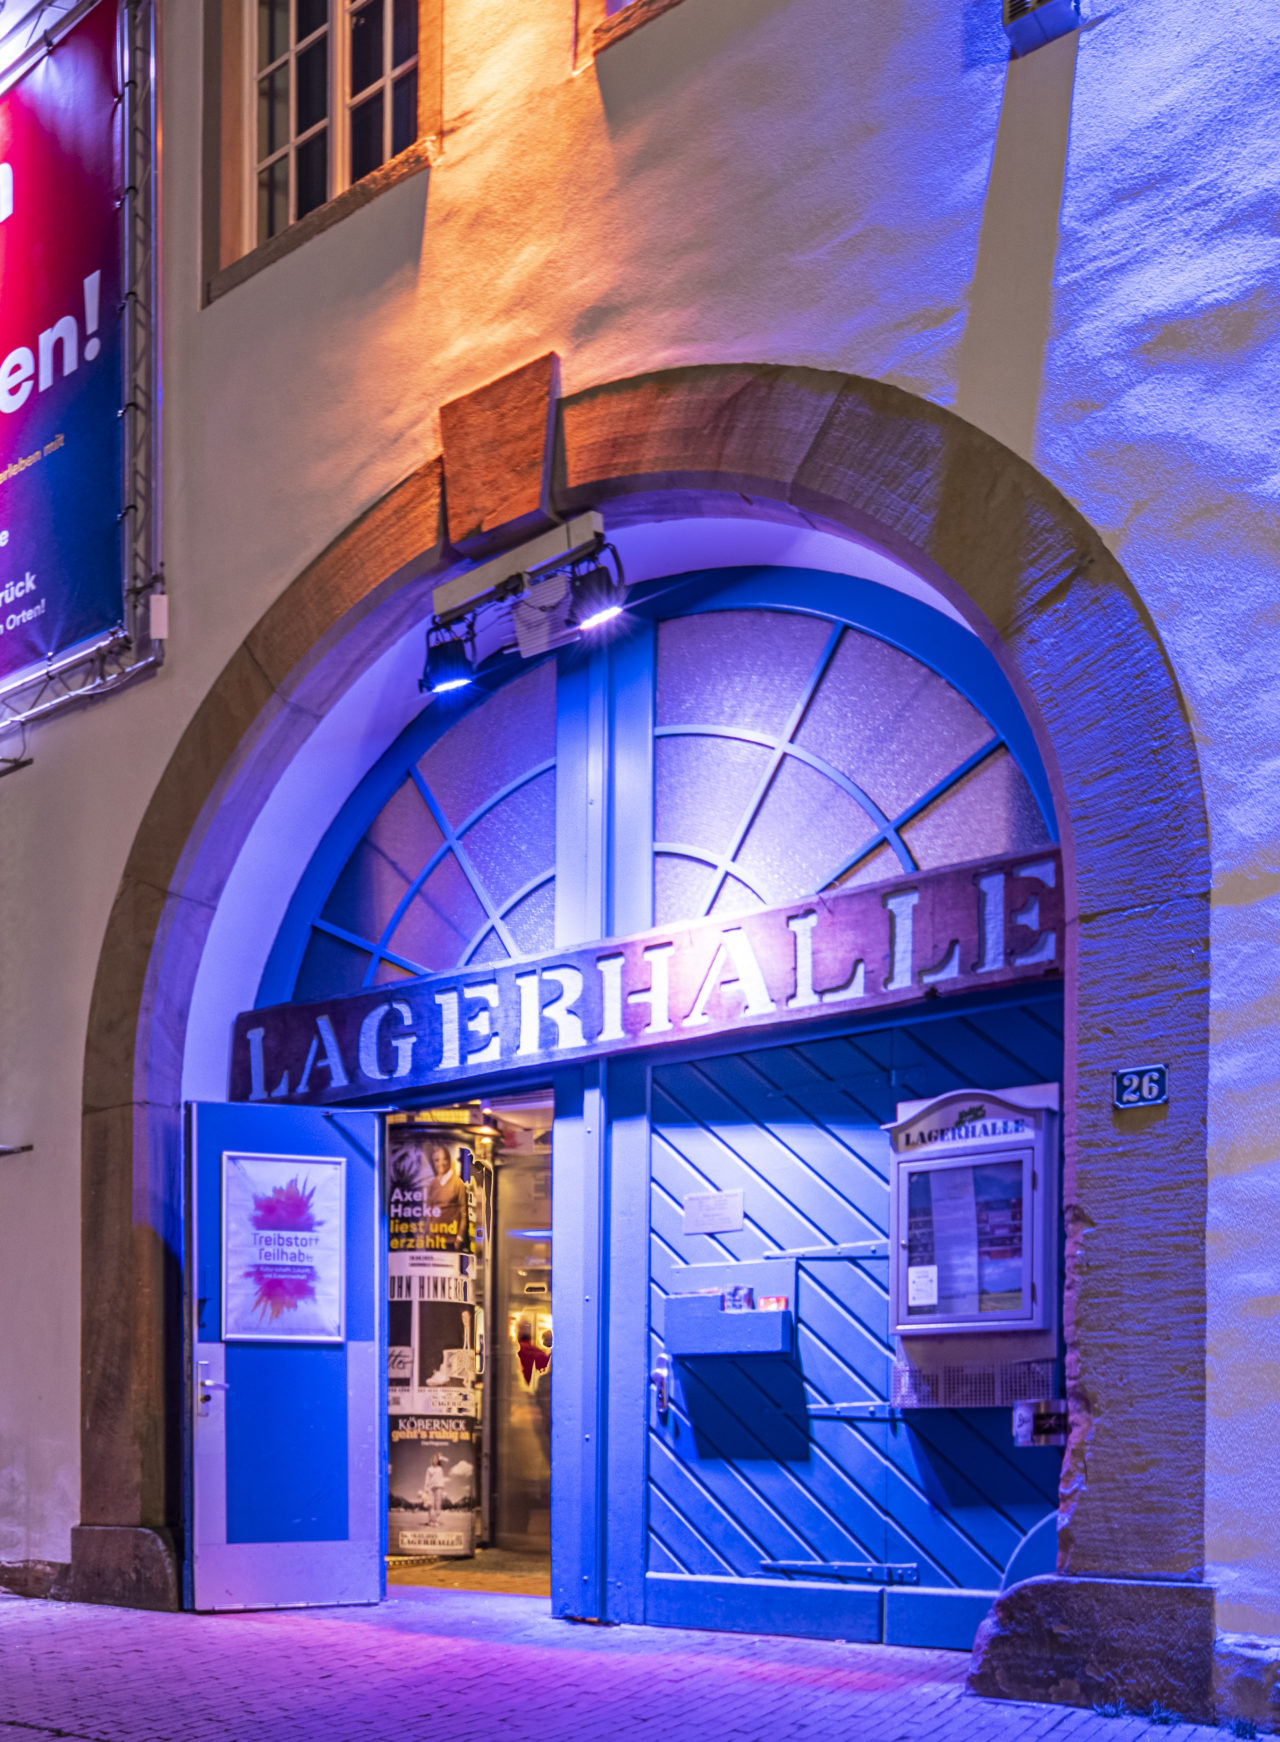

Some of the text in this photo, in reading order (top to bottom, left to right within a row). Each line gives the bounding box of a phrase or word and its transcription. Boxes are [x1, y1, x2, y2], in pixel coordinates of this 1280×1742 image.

[44, 433, 65, 456] mit
[6, 598, 47, 631] Orten!
[245, 856, 1058, 1101] LAGERHALLE
[1123, 1071, 1160, 1102] 26
[905, 1119, 1025, 1147] LAGERHALLE
[391, 1188, 428, 1202] Axel
[390, 1204, 442, 1218] Hacke
[390, 1219, 458, 1235] liest und
[390, 1235, 447, 1250] erzählt
[399, 1416, 466, 1431] KÖBERNICK
